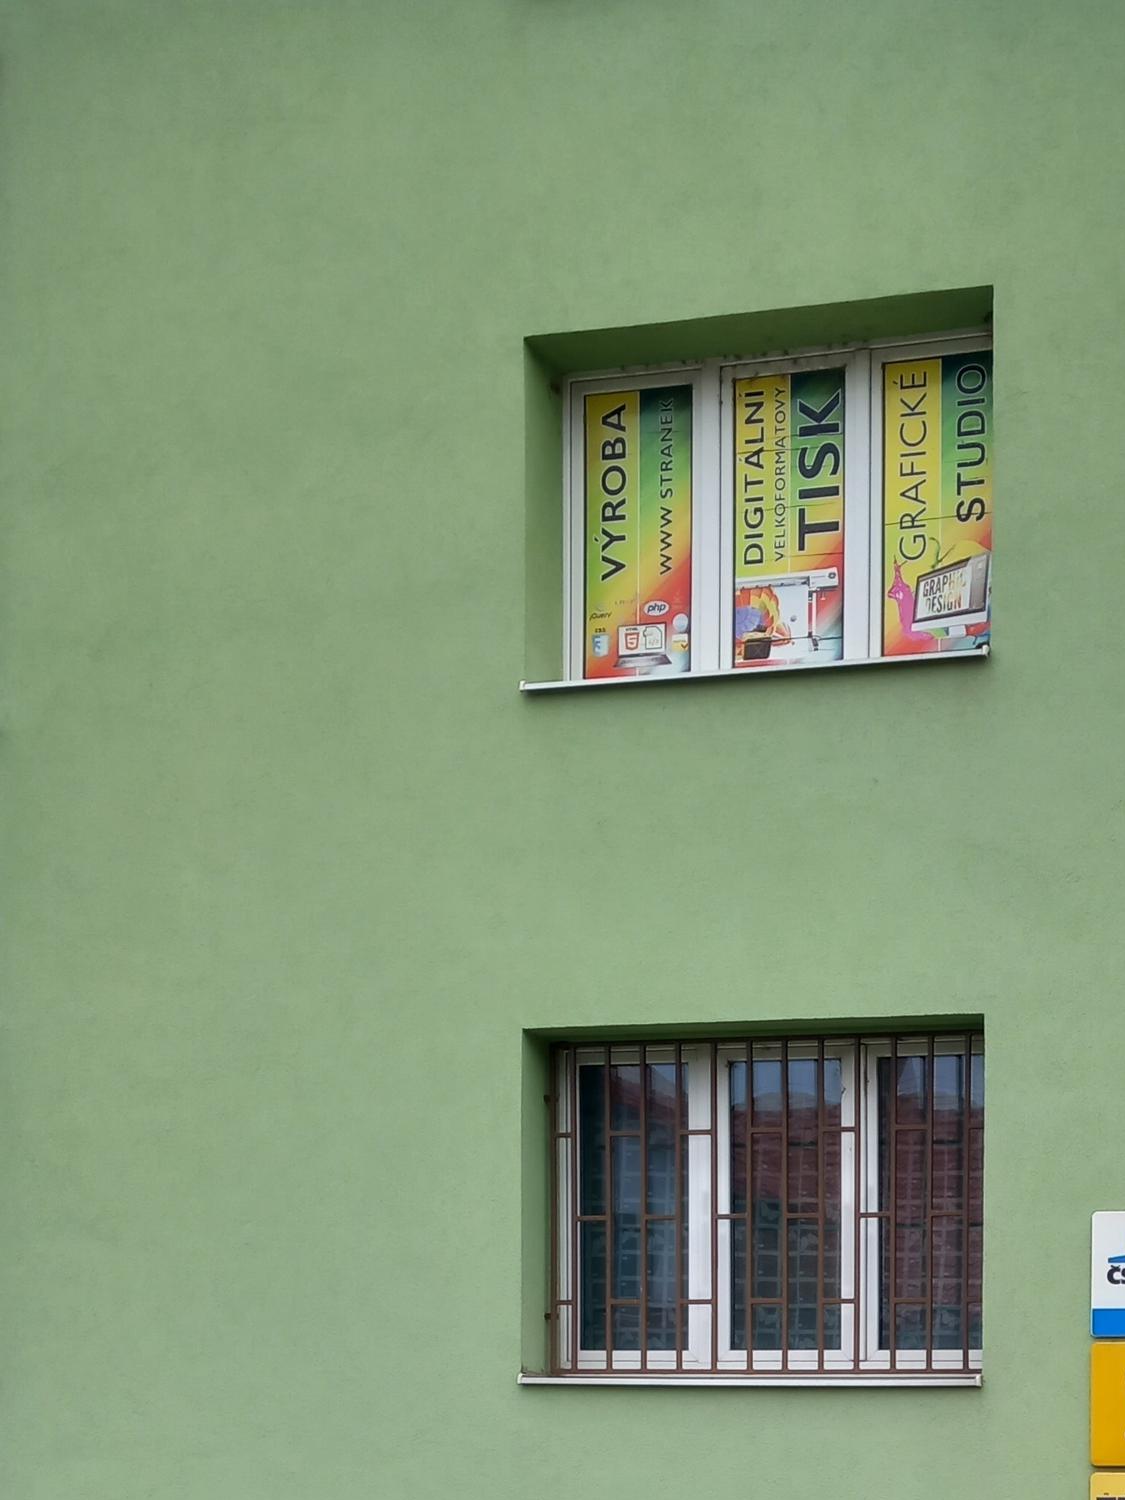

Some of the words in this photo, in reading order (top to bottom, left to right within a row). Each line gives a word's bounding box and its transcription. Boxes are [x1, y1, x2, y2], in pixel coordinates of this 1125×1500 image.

[594, 404, 627, 581] VÝROBA
[739, 390, 764, 565] DIGITÁLNÍ
[798, 389, 841, 552] TISK
[893, 371, 927, 560] GRAFICKÉ
[956, 364, 986, 522] STUDIO
[647, 603, 666, 613] php
[659, 506, 673, 575] WWW
